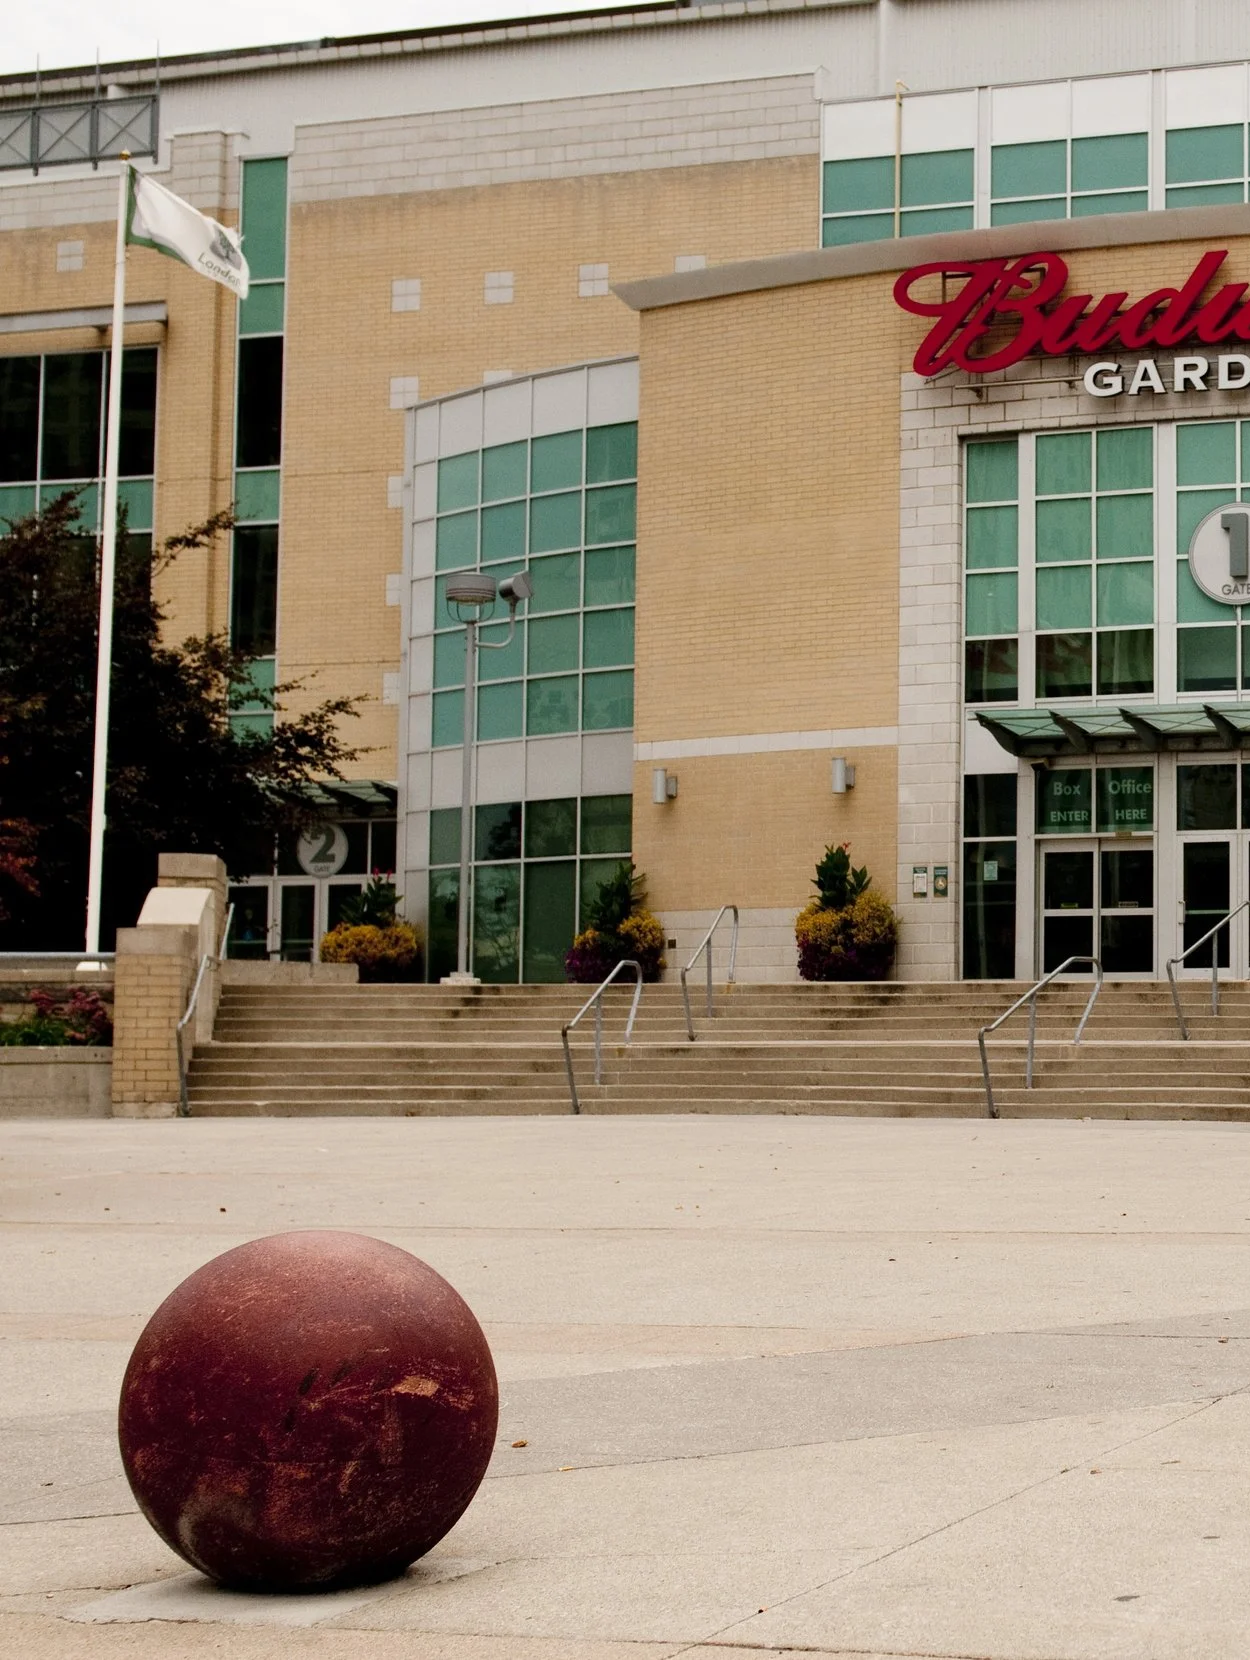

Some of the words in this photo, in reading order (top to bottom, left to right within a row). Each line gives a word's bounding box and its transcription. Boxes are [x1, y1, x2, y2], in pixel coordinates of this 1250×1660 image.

[1221, 512, 1249, 580] 1
[1053, 781, 1081, 796] Box
[1108, 779, 1152, 795] Office
[1050, 810, 1089, 822] ENTER
[1115, 808, 1147, 820] HERE
[309, 826, 336, 864] 2
